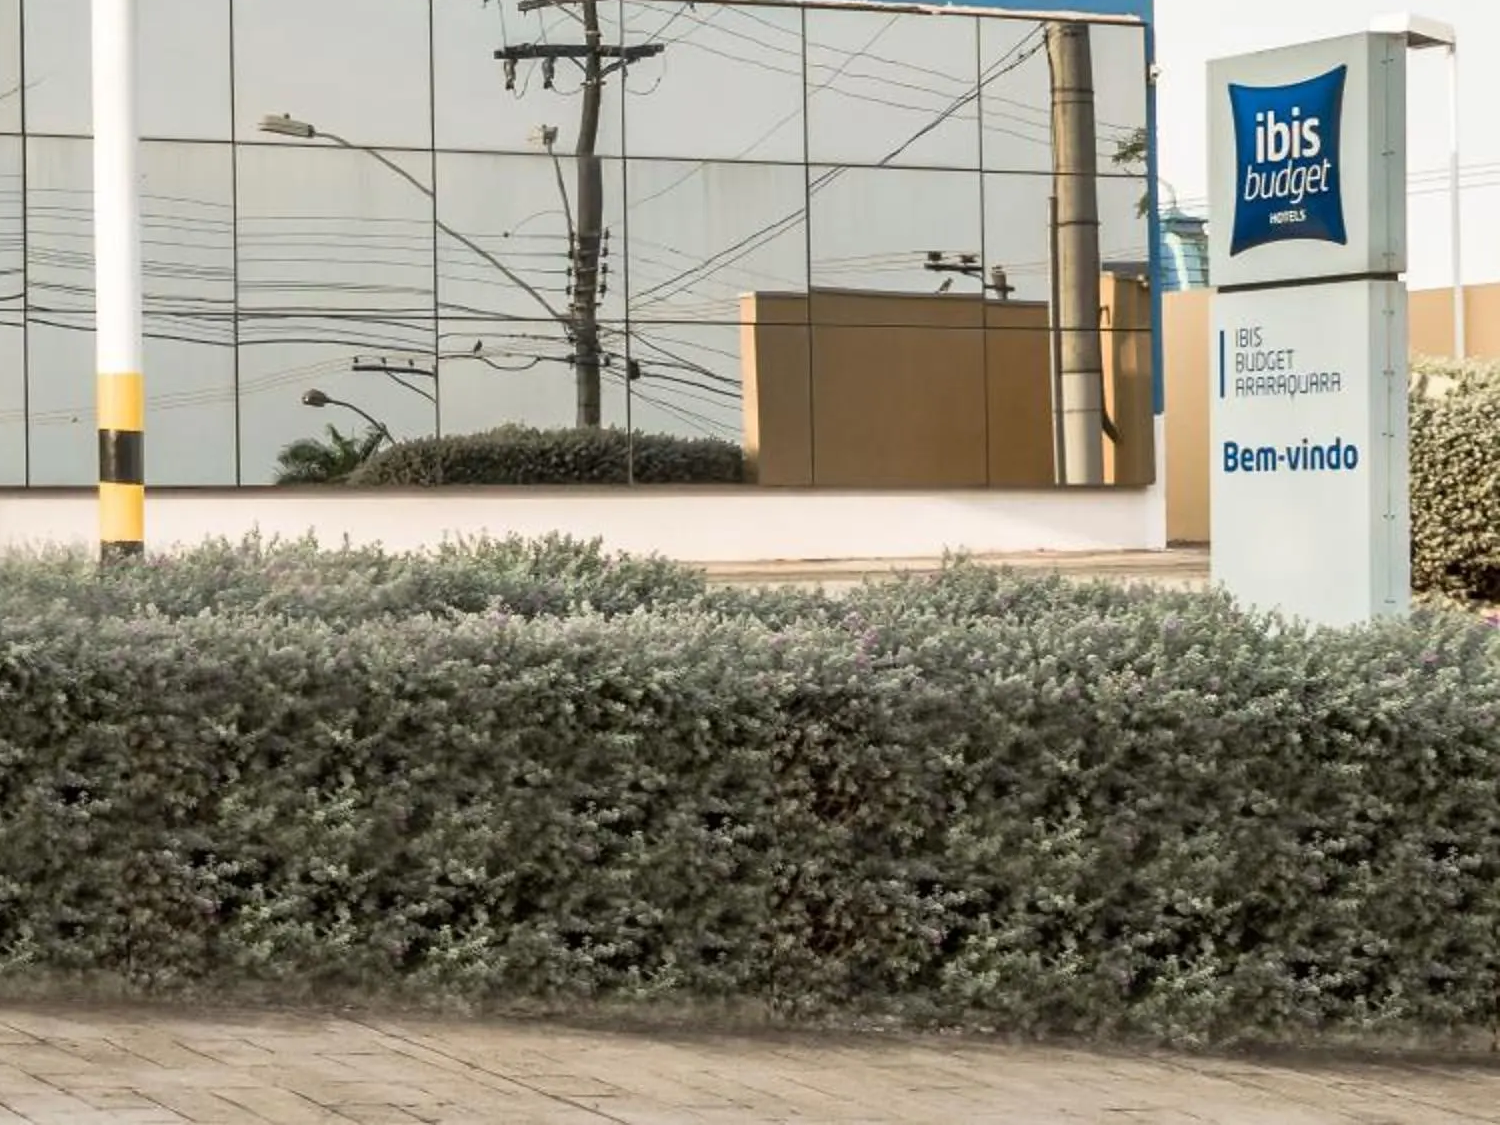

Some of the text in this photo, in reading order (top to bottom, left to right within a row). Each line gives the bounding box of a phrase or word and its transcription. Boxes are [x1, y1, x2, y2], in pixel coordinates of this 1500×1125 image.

[1255, 106, 1321, 163] ibis
[1244, 158, 1332, 204] budget
[1269, 210, 1306, 224] HOTELS
[1235, 326, 1263, 348] IBIS
[1235, 348, 1294, 373] BUDGET
[1235, 372, 1342, 400] ARARAQUARA
[1223, 437, 1359, 473] Bem-vindo
